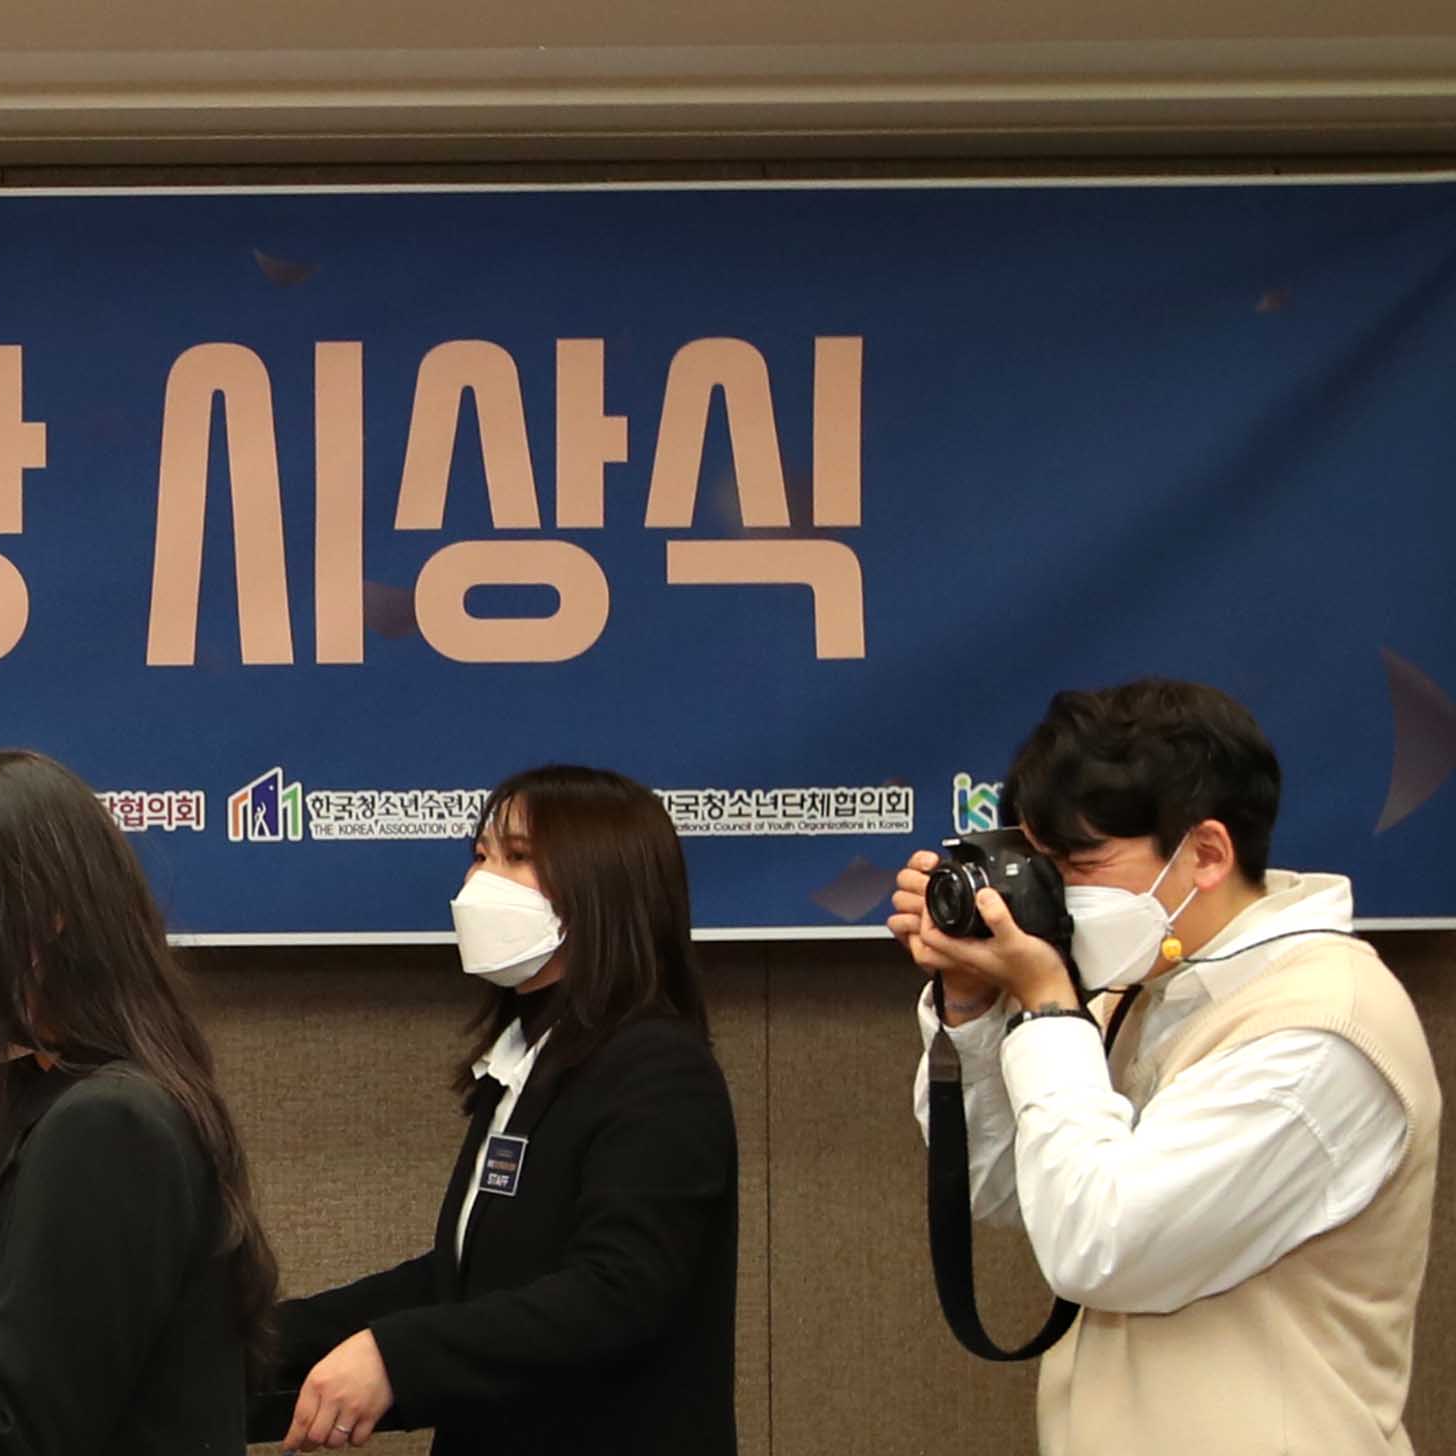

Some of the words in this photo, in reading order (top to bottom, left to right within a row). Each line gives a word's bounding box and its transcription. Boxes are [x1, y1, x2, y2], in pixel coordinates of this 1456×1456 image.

[146, 337, 865, 666] 시상식
[313, 822, 335, 836] THE
[338, 821, 374, 835] KOREA
[379, 821, 446, 835] ASSOCIATION
[451, 821, 466, 835] OF
[675, 822, 711, 832] ational
[713, 822, 752, 833] Council
